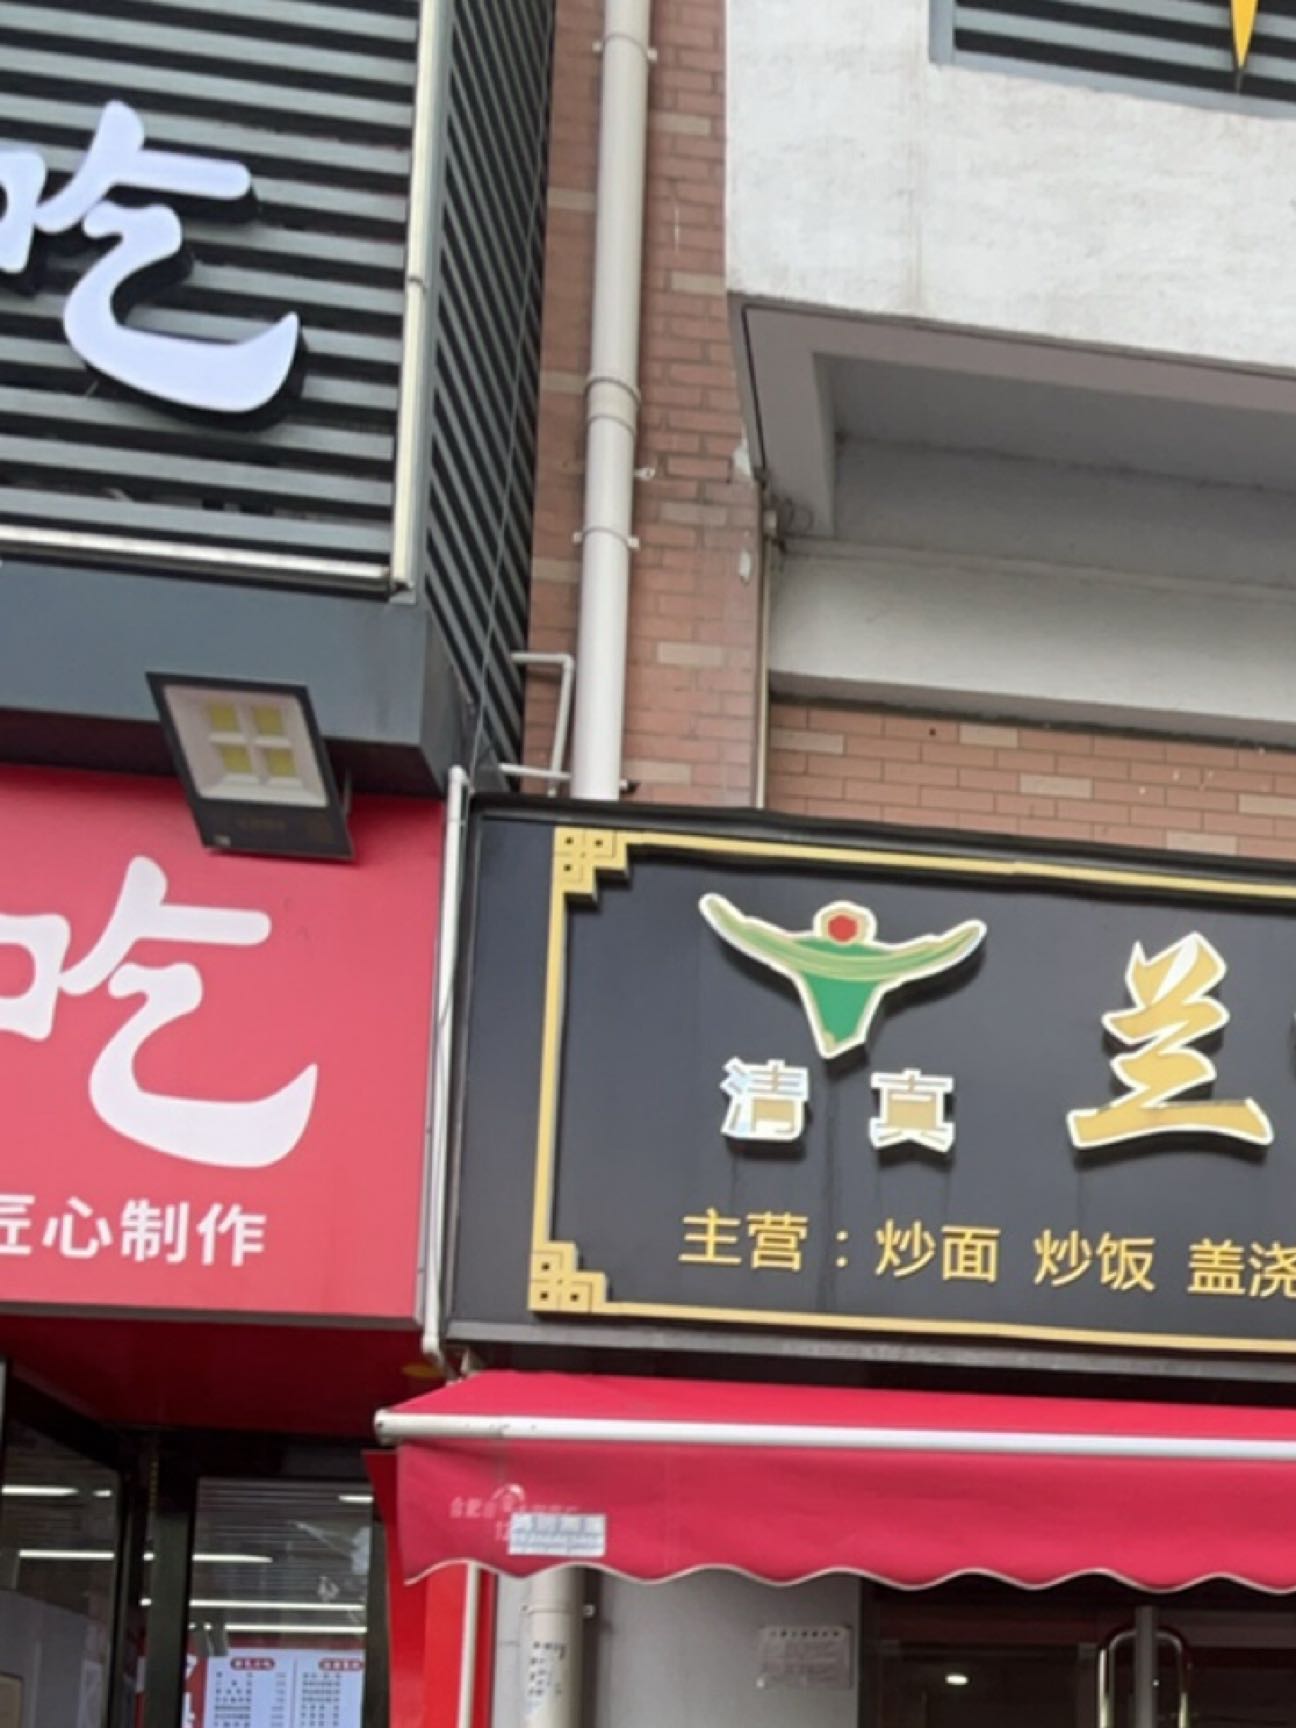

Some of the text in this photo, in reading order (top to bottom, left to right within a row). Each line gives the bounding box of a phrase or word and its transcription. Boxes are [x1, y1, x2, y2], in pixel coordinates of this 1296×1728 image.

[0, 856, 318, 1168] 吃
[719, 1057, 955, 1153] 清真
[1032, 1228, 1156, 1293] 炒饭
